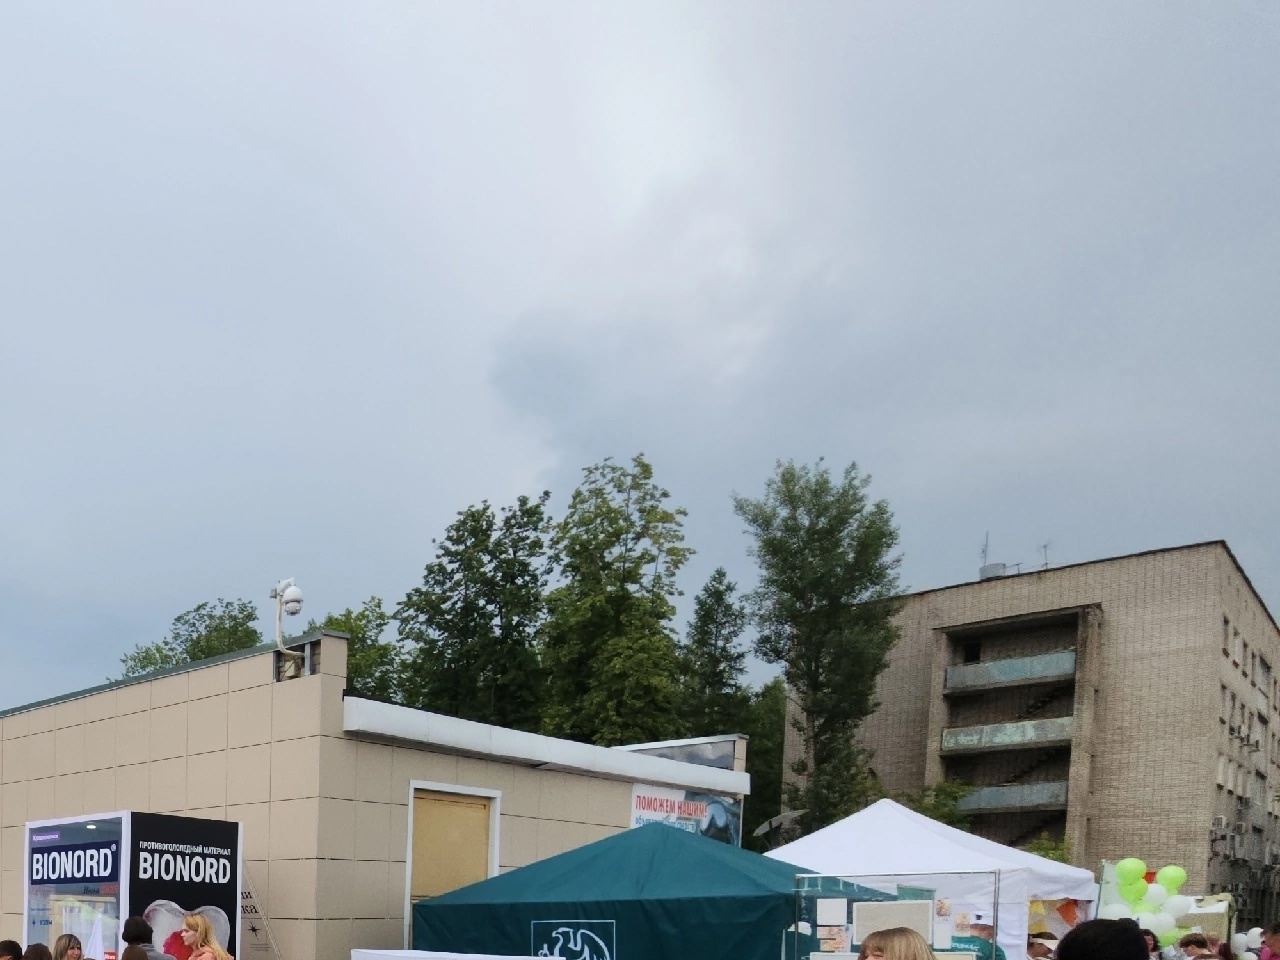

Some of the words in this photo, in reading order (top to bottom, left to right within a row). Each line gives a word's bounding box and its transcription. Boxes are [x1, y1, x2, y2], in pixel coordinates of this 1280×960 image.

[636, 795, 676, 814] ПОМОЖЕМ
[677, 800, 708, 818] НАШИМ!
[138, 851, 231, 884] BIONORD
